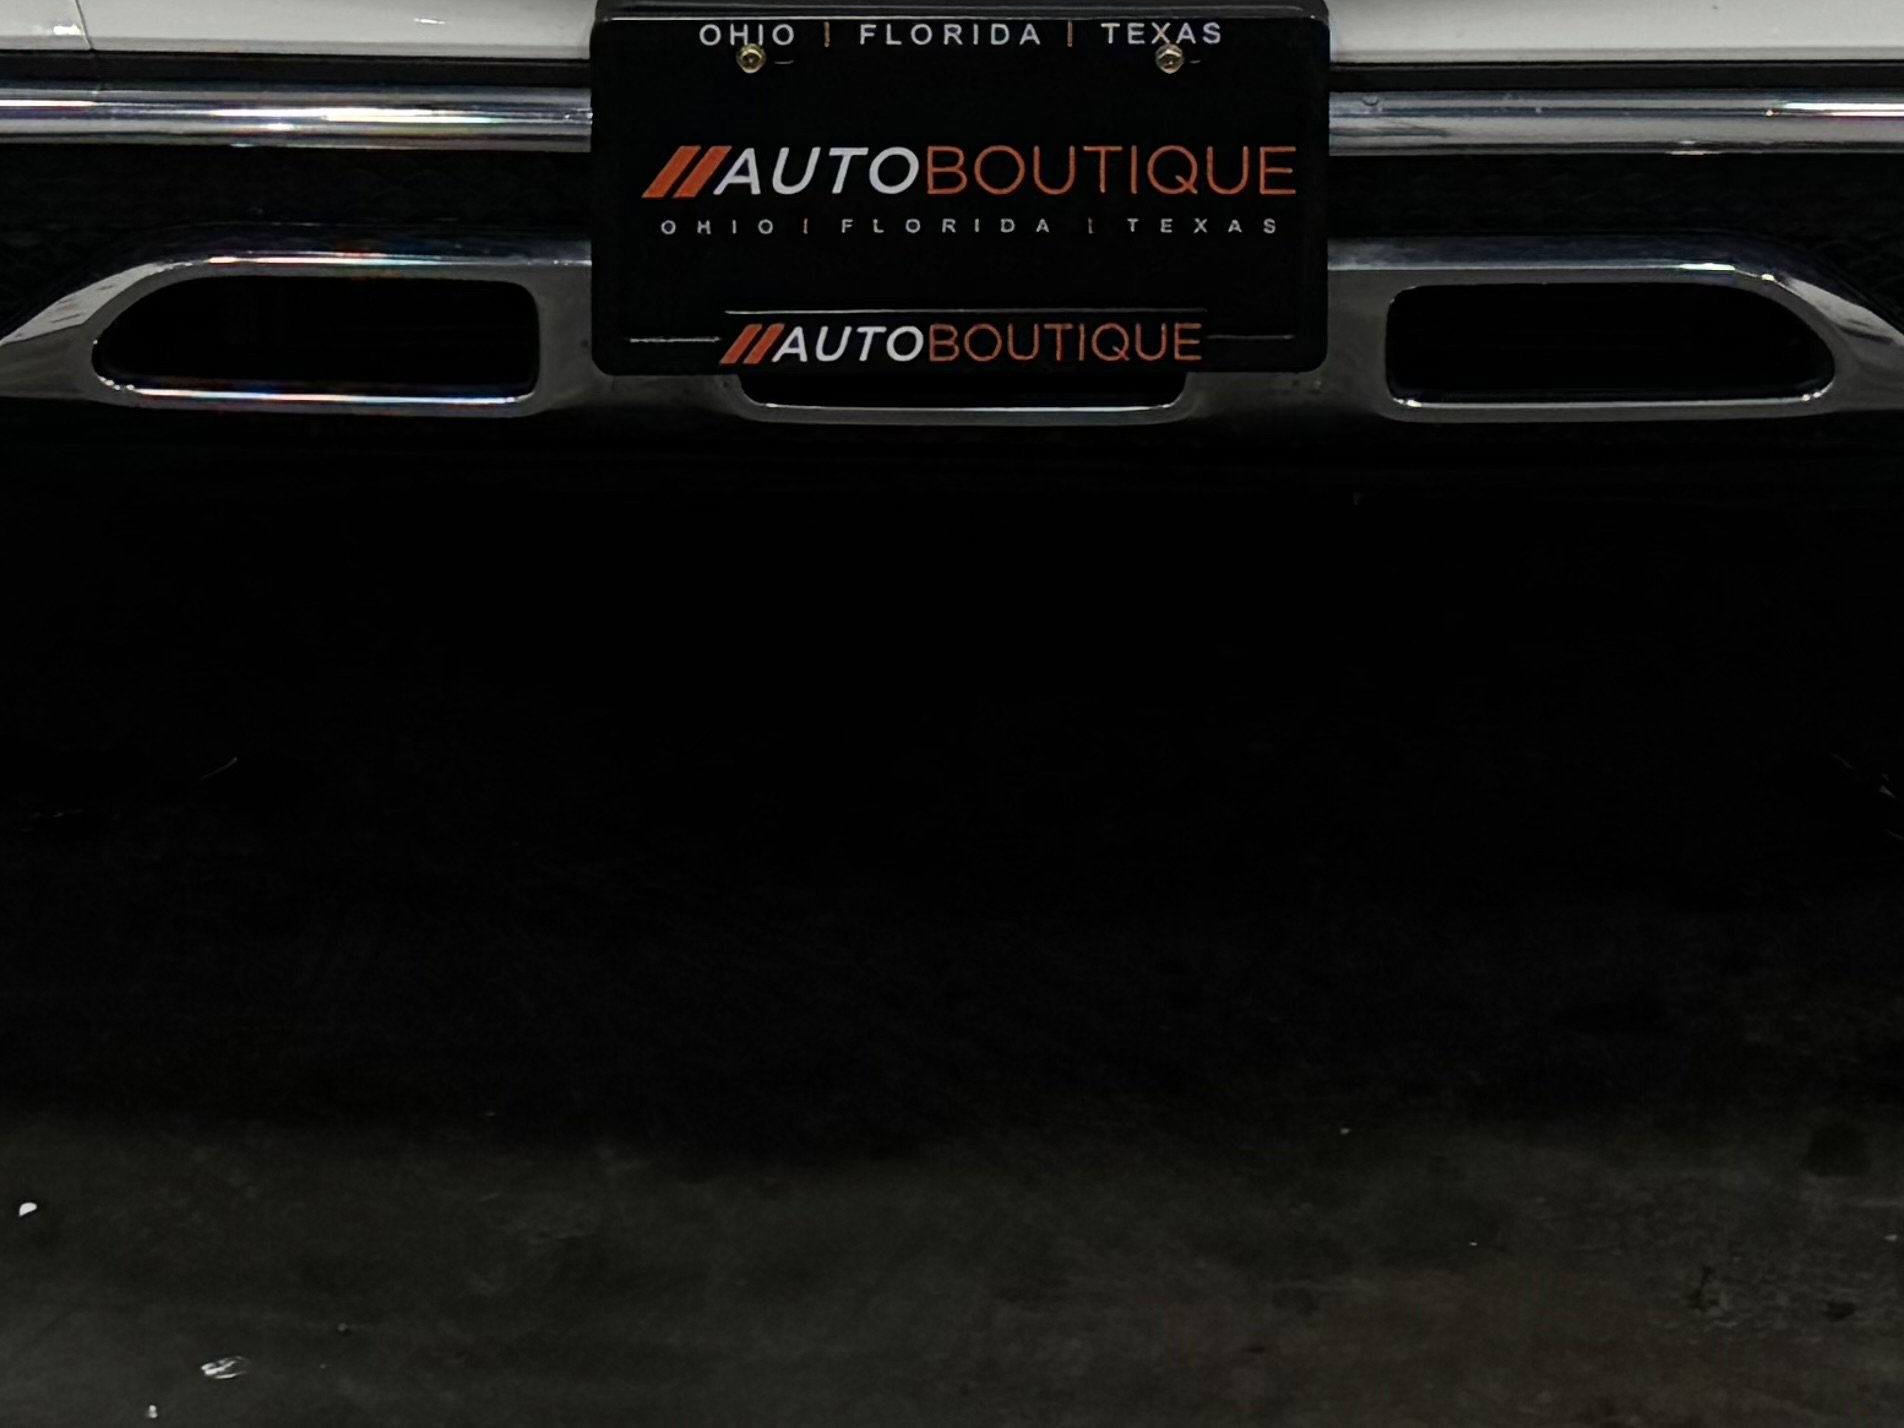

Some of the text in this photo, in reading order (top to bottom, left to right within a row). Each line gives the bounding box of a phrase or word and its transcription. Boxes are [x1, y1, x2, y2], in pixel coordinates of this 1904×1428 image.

[699, 23, 795, 47] OHIO
[860, 23, 1041, 47] FLORIDA
[1101, 22, 1222, 46] TEXAS
[661, 219, 775, 236] OHIO
[841, 218, 1051, 235] FLORIDA
[1127, 217, 1278, 235] TEXAS
